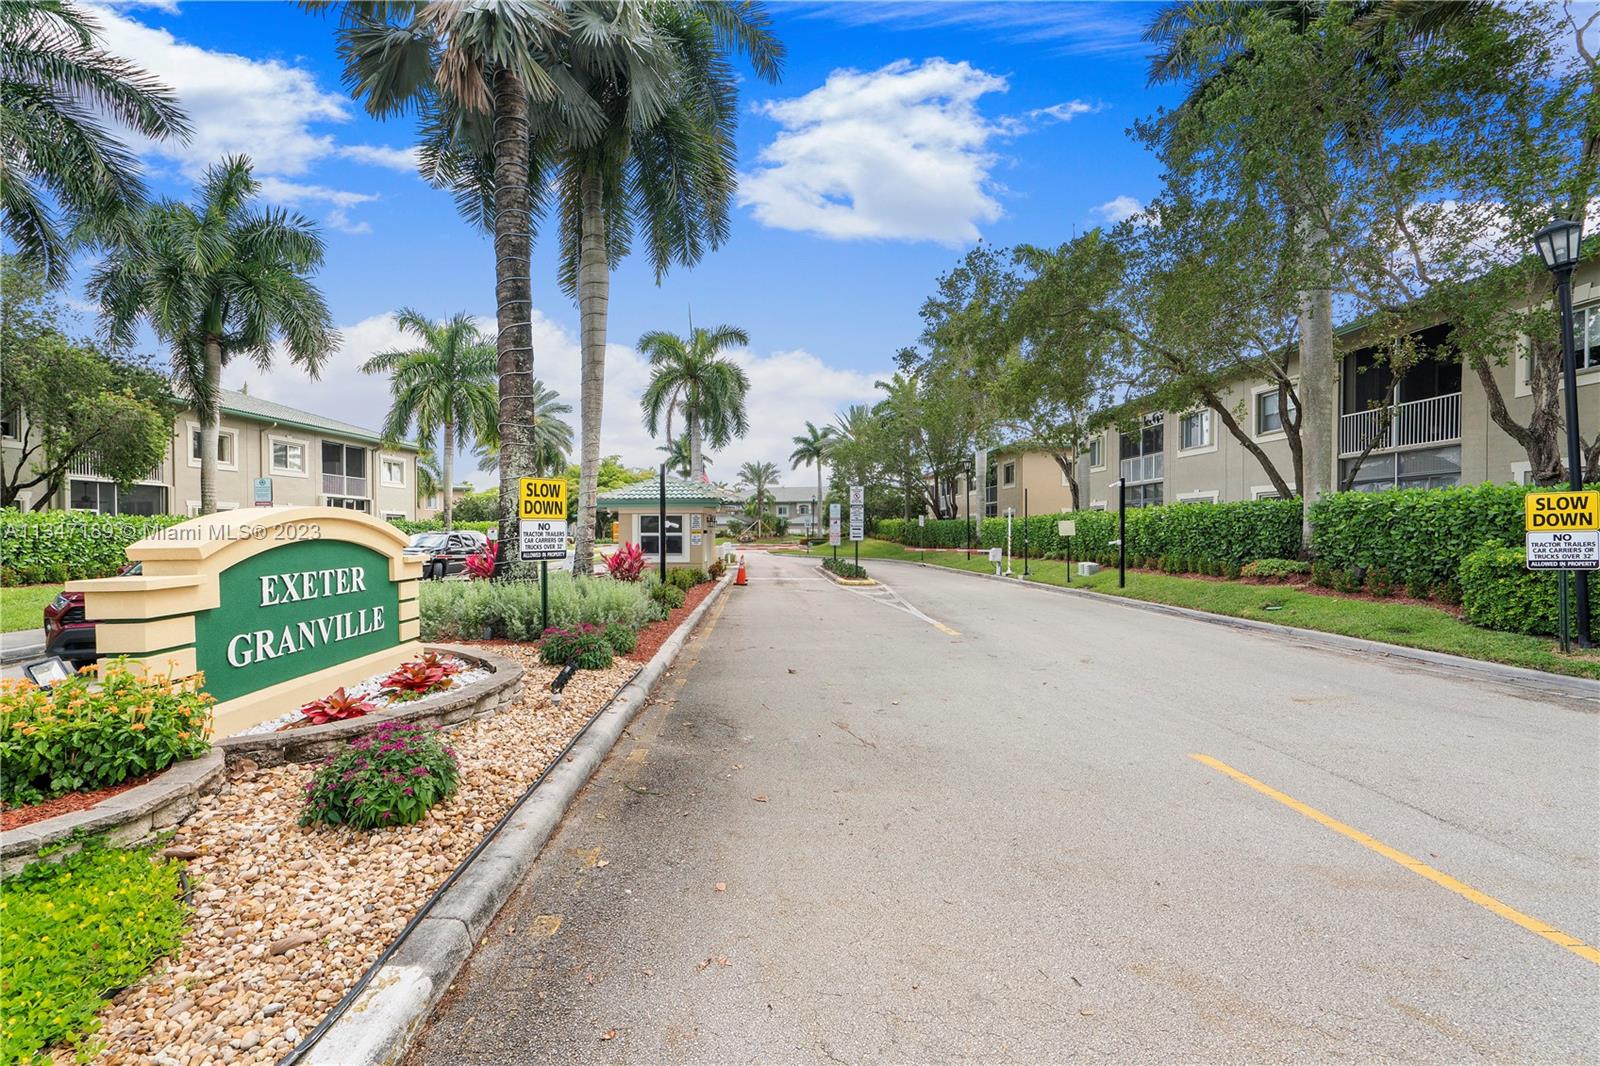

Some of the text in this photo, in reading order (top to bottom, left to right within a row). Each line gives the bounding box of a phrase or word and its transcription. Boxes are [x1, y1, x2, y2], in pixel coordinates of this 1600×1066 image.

[526, 482, 561, 498] SLOW
[524, 500, 563, 515] DOWN
[1535, 496, 1589, 511] SLOW
[537, 523, 551, 531] NO
[1533, 512, 1593, 527] DOWN
[1552, 533, 1572, 541] NO
[259, 566, 367, 607] EXETER
[226, 605, 385, 669] GRANVILLE
